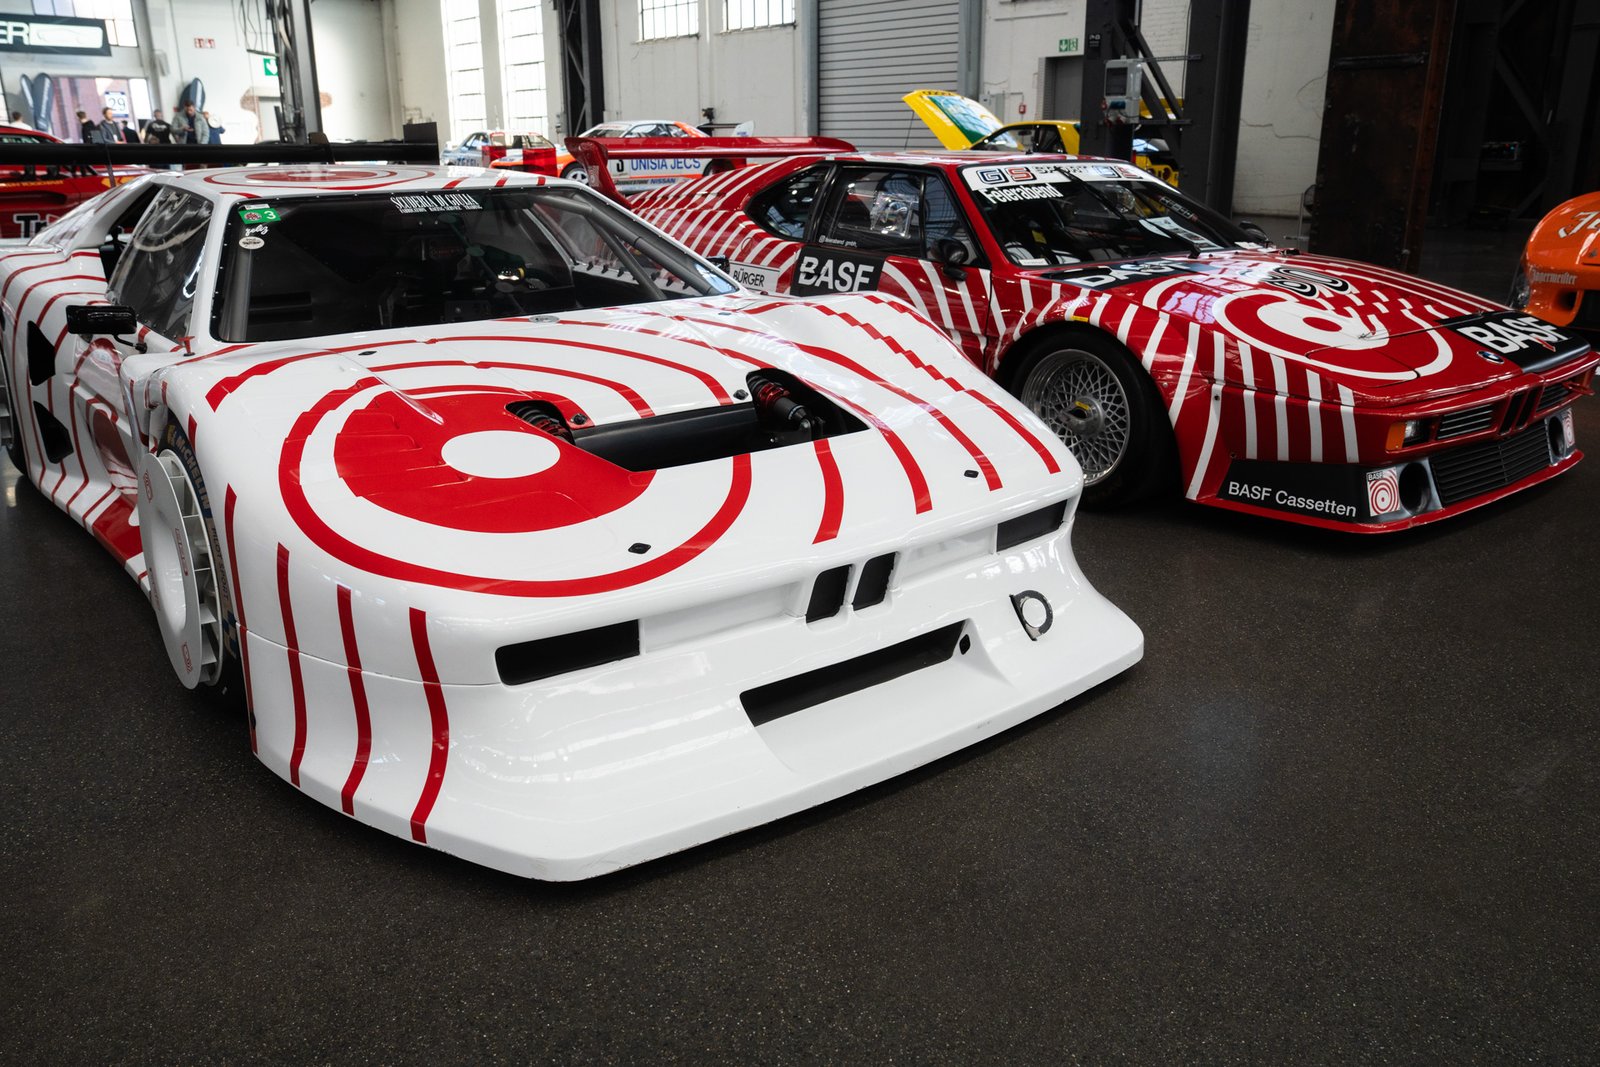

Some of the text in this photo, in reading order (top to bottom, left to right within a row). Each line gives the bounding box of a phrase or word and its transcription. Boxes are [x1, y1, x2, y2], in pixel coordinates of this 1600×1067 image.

[631, 158, 701, 171] UNISIA JECS
[976, 166, 1037, 185] GS
[390, 195, 439, 209] SCUDERIA
[980, 182, 1064, 204] Feierabend
[264, 210, 276, 220] 3
[733, 268, 765, 287] BÜRGER
[798, 256, 875, 292] BASF
[1456, 317, 1569, 354] BASF
[1367, 471, 1383, 481] BASF
[1228, 481, 1357, 518] BASF Cassetten
